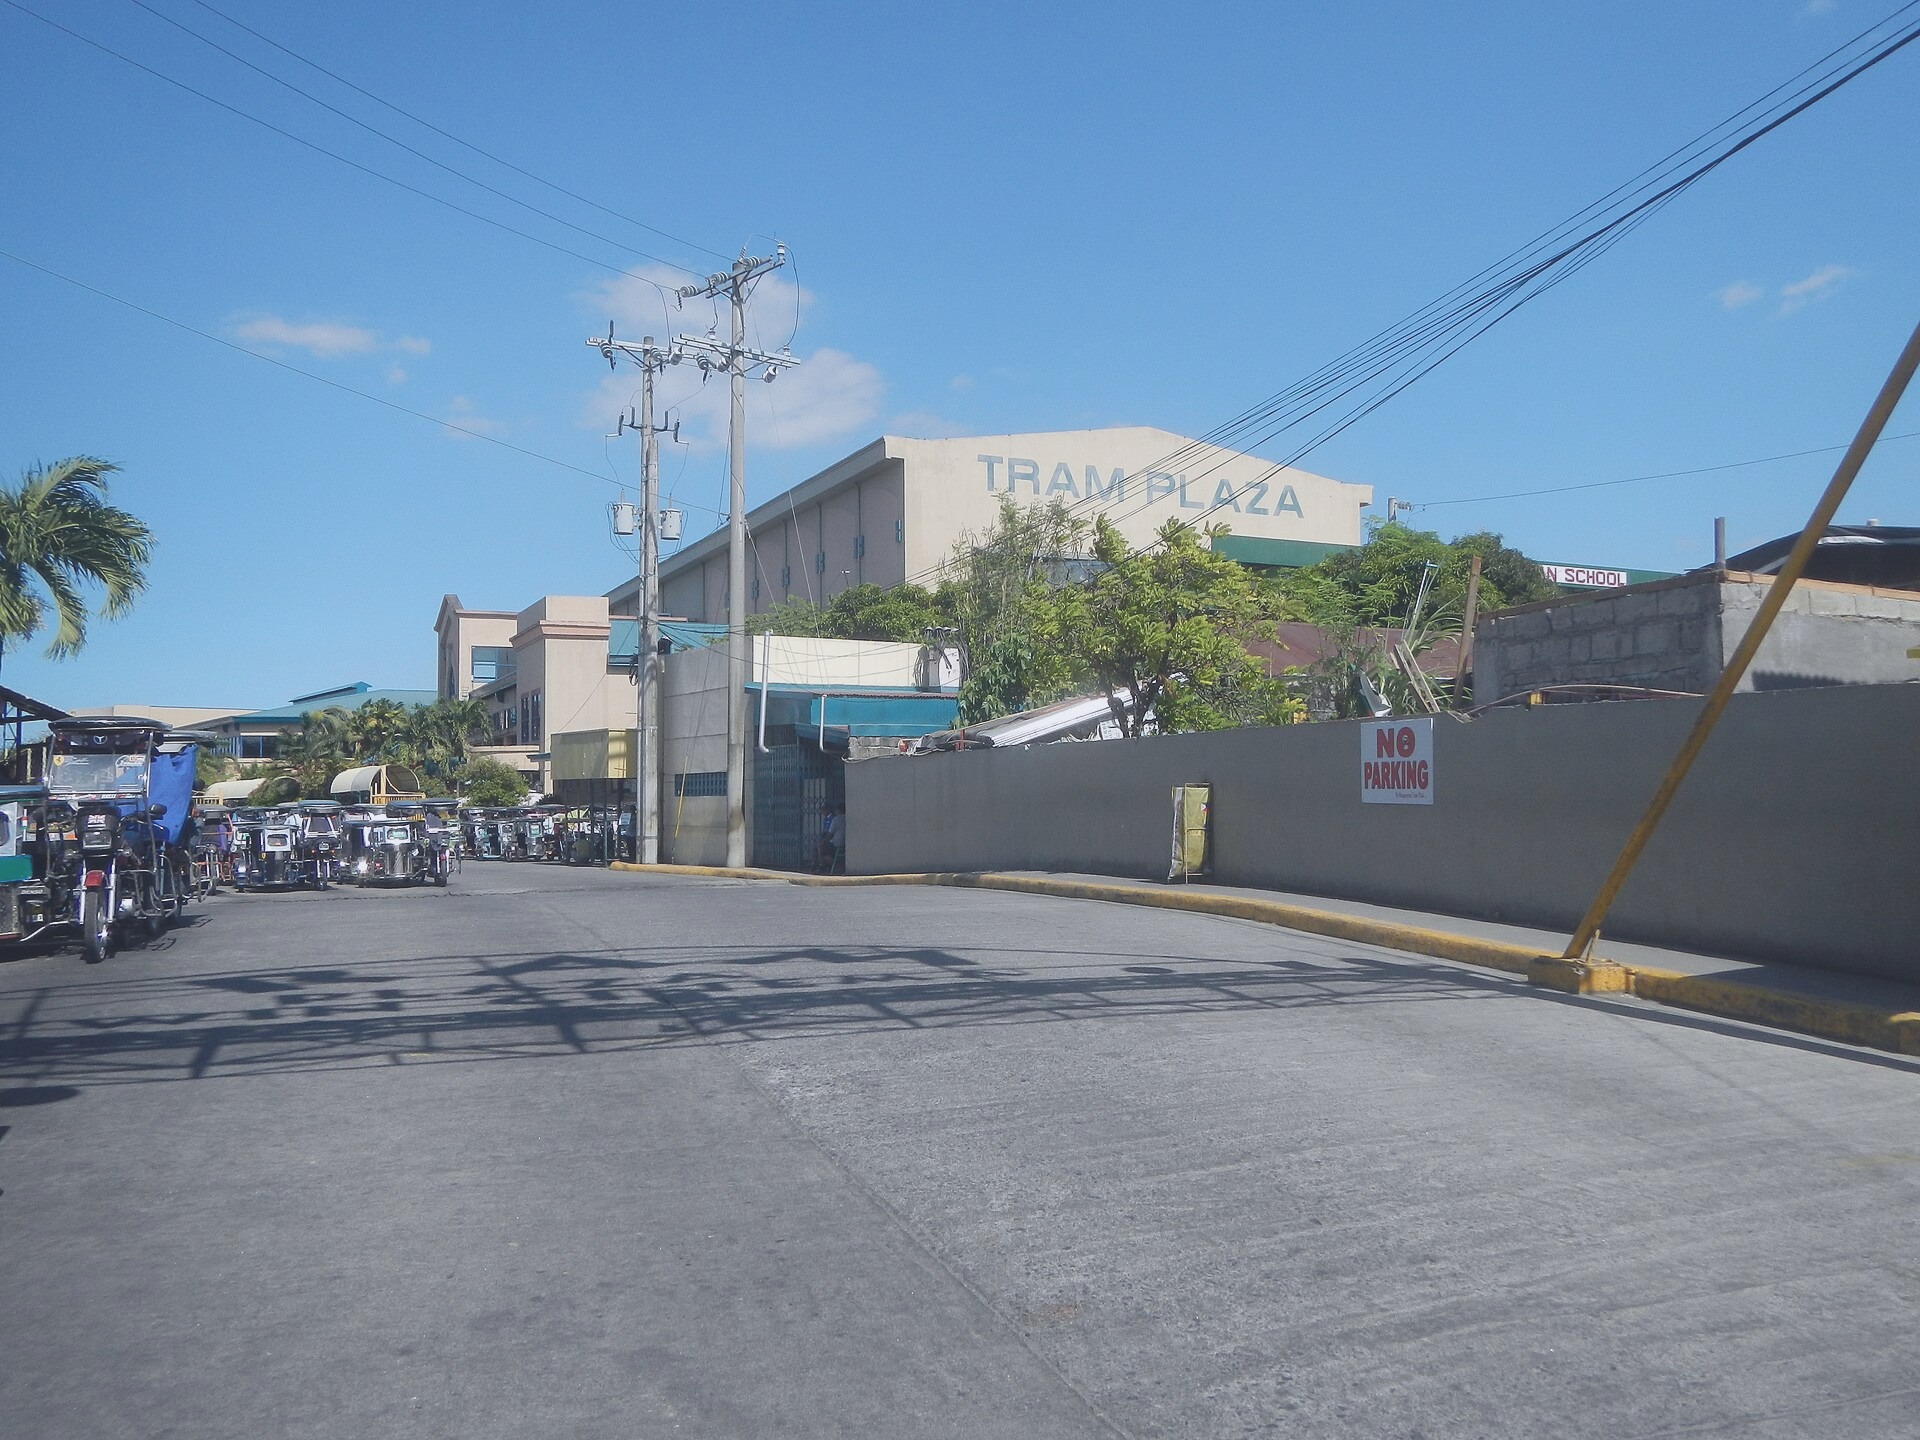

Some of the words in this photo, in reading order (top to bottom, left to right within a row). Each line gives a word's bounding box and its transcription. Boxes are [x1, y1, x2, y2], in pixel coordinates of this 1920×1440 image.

[977, 454, 1125, 502] TRAM
[1146, 471, 1304, 518] PLAZA
[1564, 568, 1625, 587] SCHOOL
[1376, 726, 1415, 758] NO
[1364, 760, 1429, 790] PARKING
